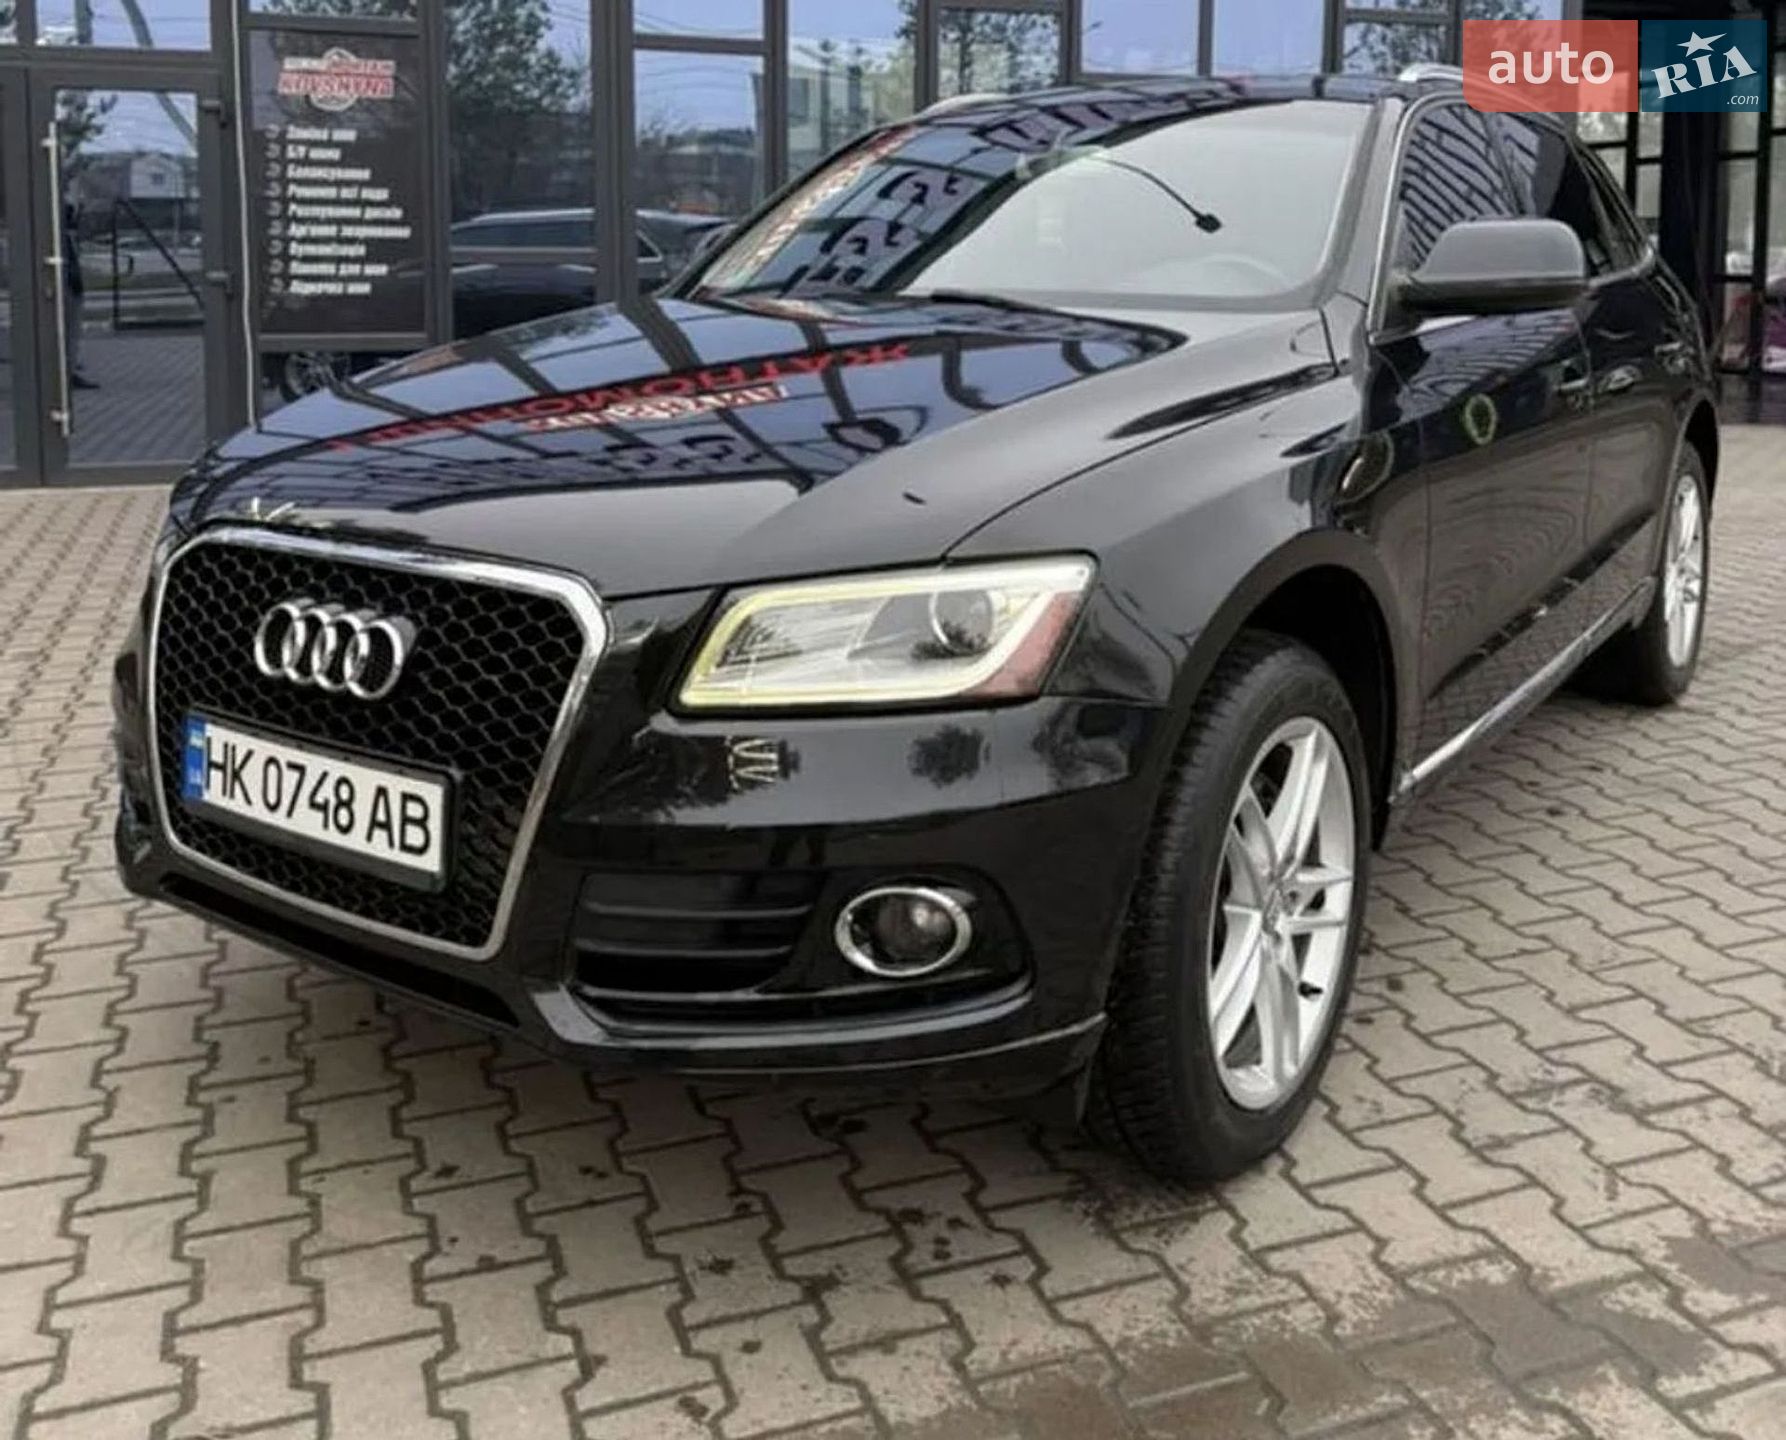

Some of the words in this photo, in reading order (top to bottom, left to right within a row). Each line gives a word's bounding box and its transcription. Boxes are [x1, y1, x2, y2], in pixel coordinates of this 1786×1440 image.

[205, 735, 256, 807] HK
[261, 754, 356, 836] 0748
[365, 784, 432, 856] AB
